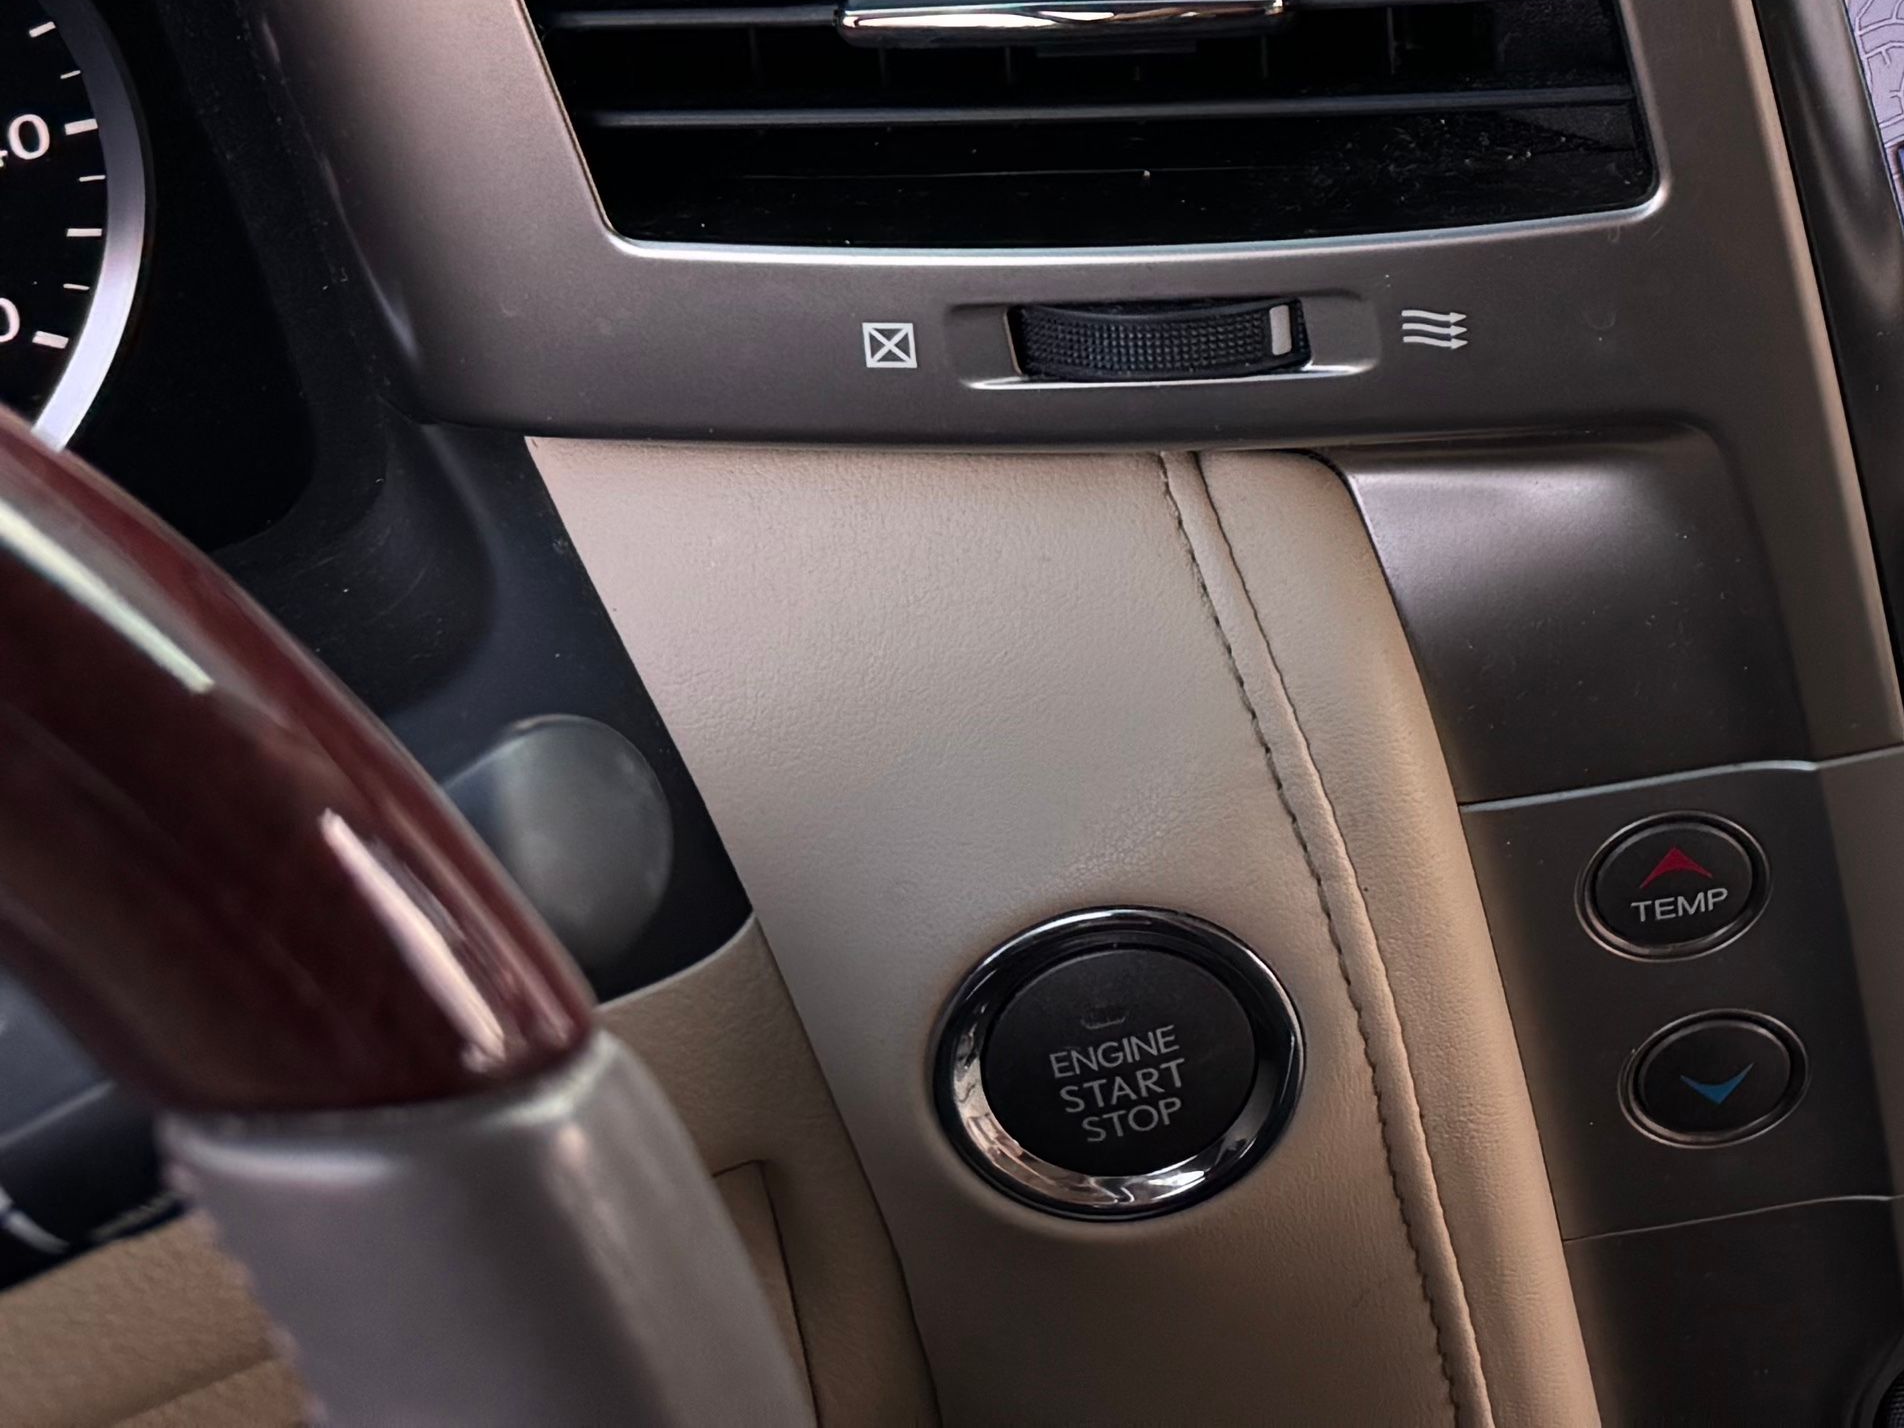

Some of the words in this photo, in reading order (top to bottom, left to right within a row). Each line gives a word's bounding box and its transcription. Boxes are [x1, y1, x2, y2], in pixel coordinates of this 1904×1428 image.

[1631, 887, 1729, 924] TEMP
[1048, 1024, 1181, 1081] ENGINE
[1059, 1057, 1186, 1115] START
[1081, 1097, 1183, 1142] STOP
